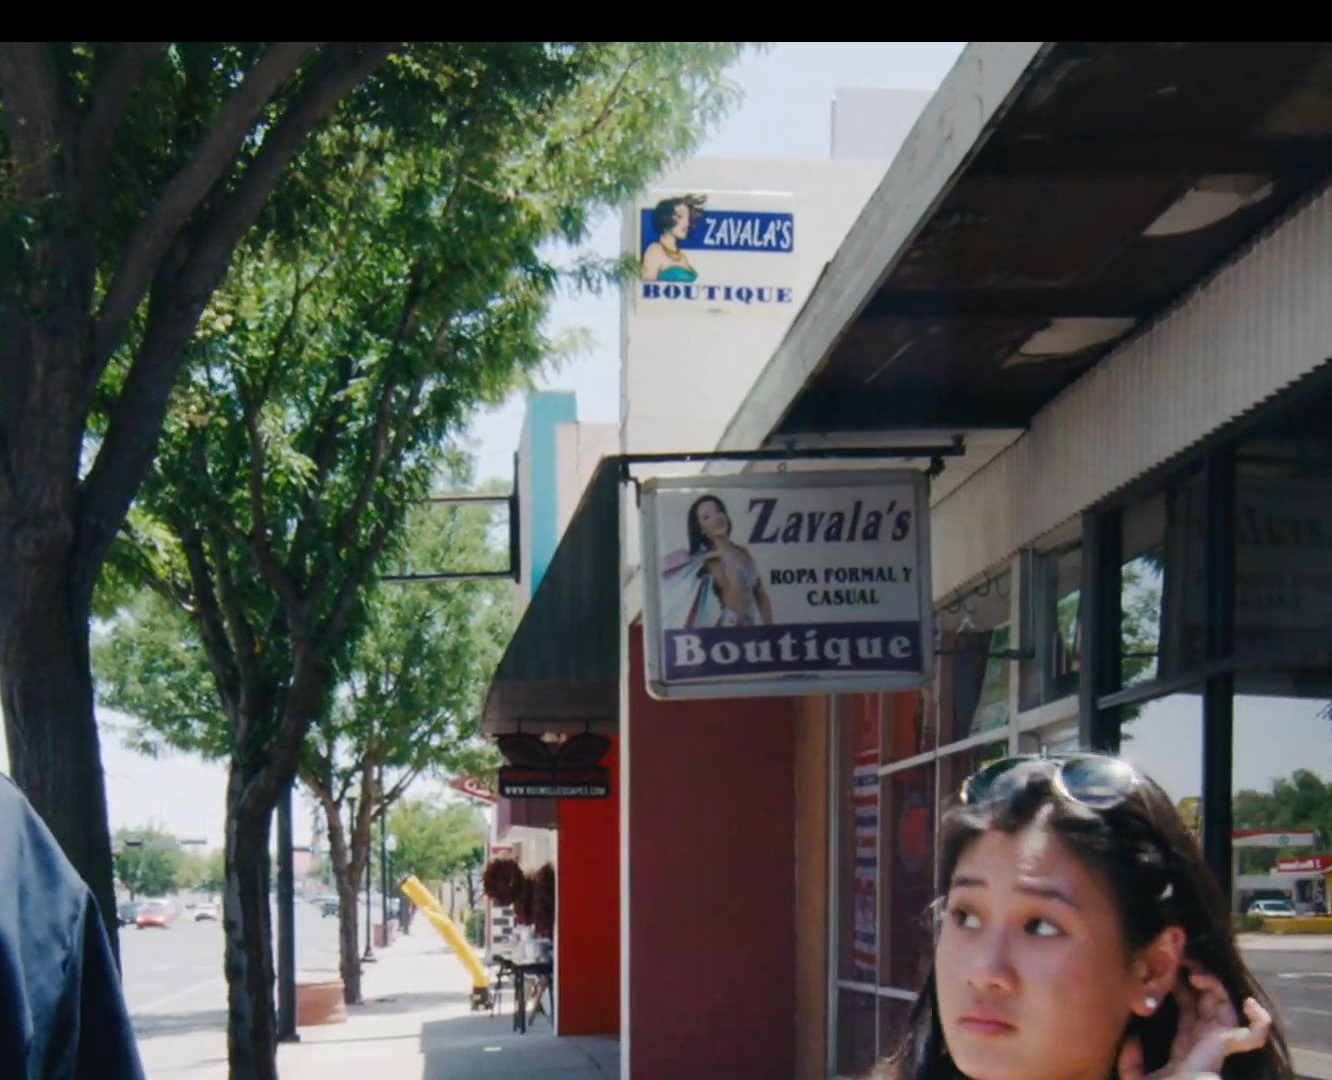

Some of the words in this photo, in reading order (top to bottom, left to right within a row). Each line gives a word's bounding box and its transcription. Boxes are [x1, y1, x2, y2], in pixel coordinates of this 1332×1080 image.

[703, 217, 792, 249] ZAVALA'S
[642, 283, 793, 304] BOUTIQUE
[748, 498, 912, 544] Zavala's
[770, 569, 818, 585] ROPA
[824, 567, 898, 583] FORMAL
[903, 566, 914, 583] Y
[806, 590, 881, 606] CASUAL
[672, 630, 912, 667] Boutique
